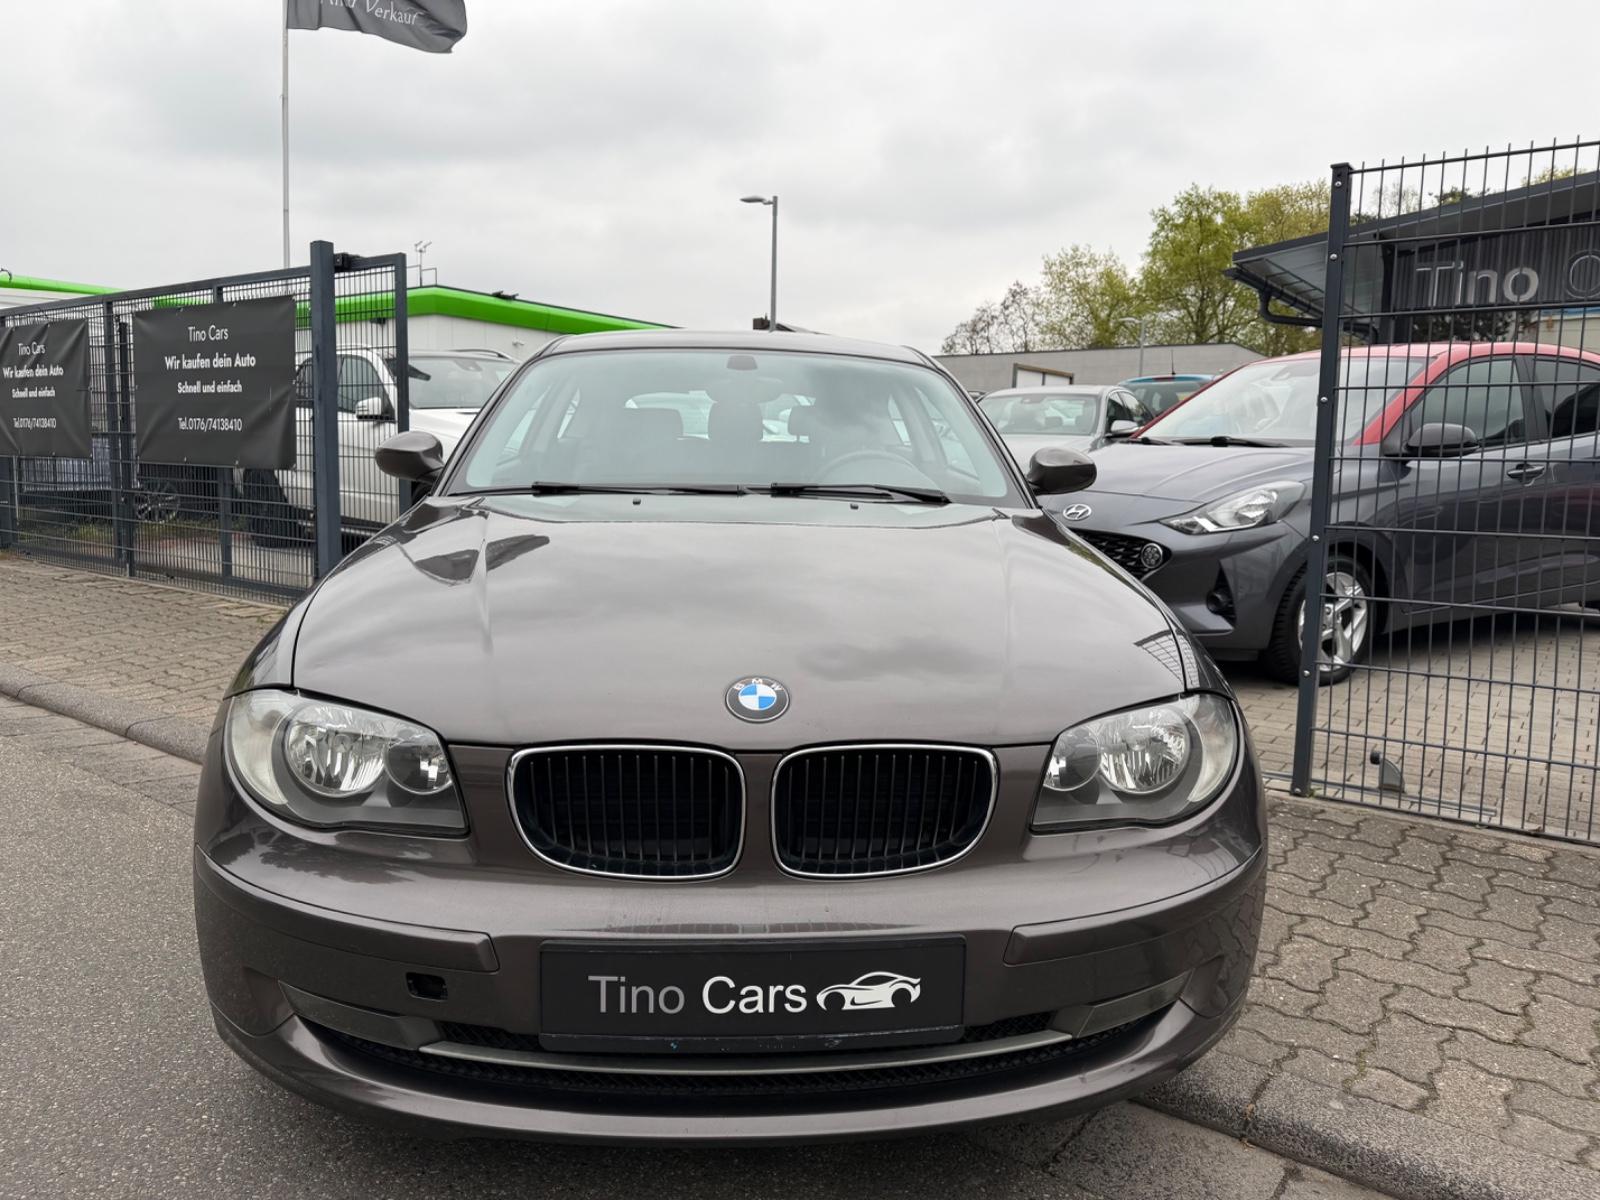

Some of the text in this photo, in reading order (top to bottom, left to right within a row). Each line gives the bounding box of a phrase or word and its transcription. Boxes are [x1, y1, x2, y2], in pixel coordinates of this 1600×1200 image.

[1415, 260, 1539, 307] Tino
[187, 324, 229, 342] Tino Cars
[18, 341, 46, 356] Tino Cars
[164, 352, 257, 370] Wir kaufen dein Auto
[2, 363, 64, 378] Wir kaufen dein Auto
[12, 386, 56, 398] Schnell und einfach
[177, 379, 243, 394] Schnell und einfach
[177, 417, 243, 432] Tel.0176/74138410
[732, 677, 785, 691] BMW
[587, 974, 809, 1015] Tino Cars
